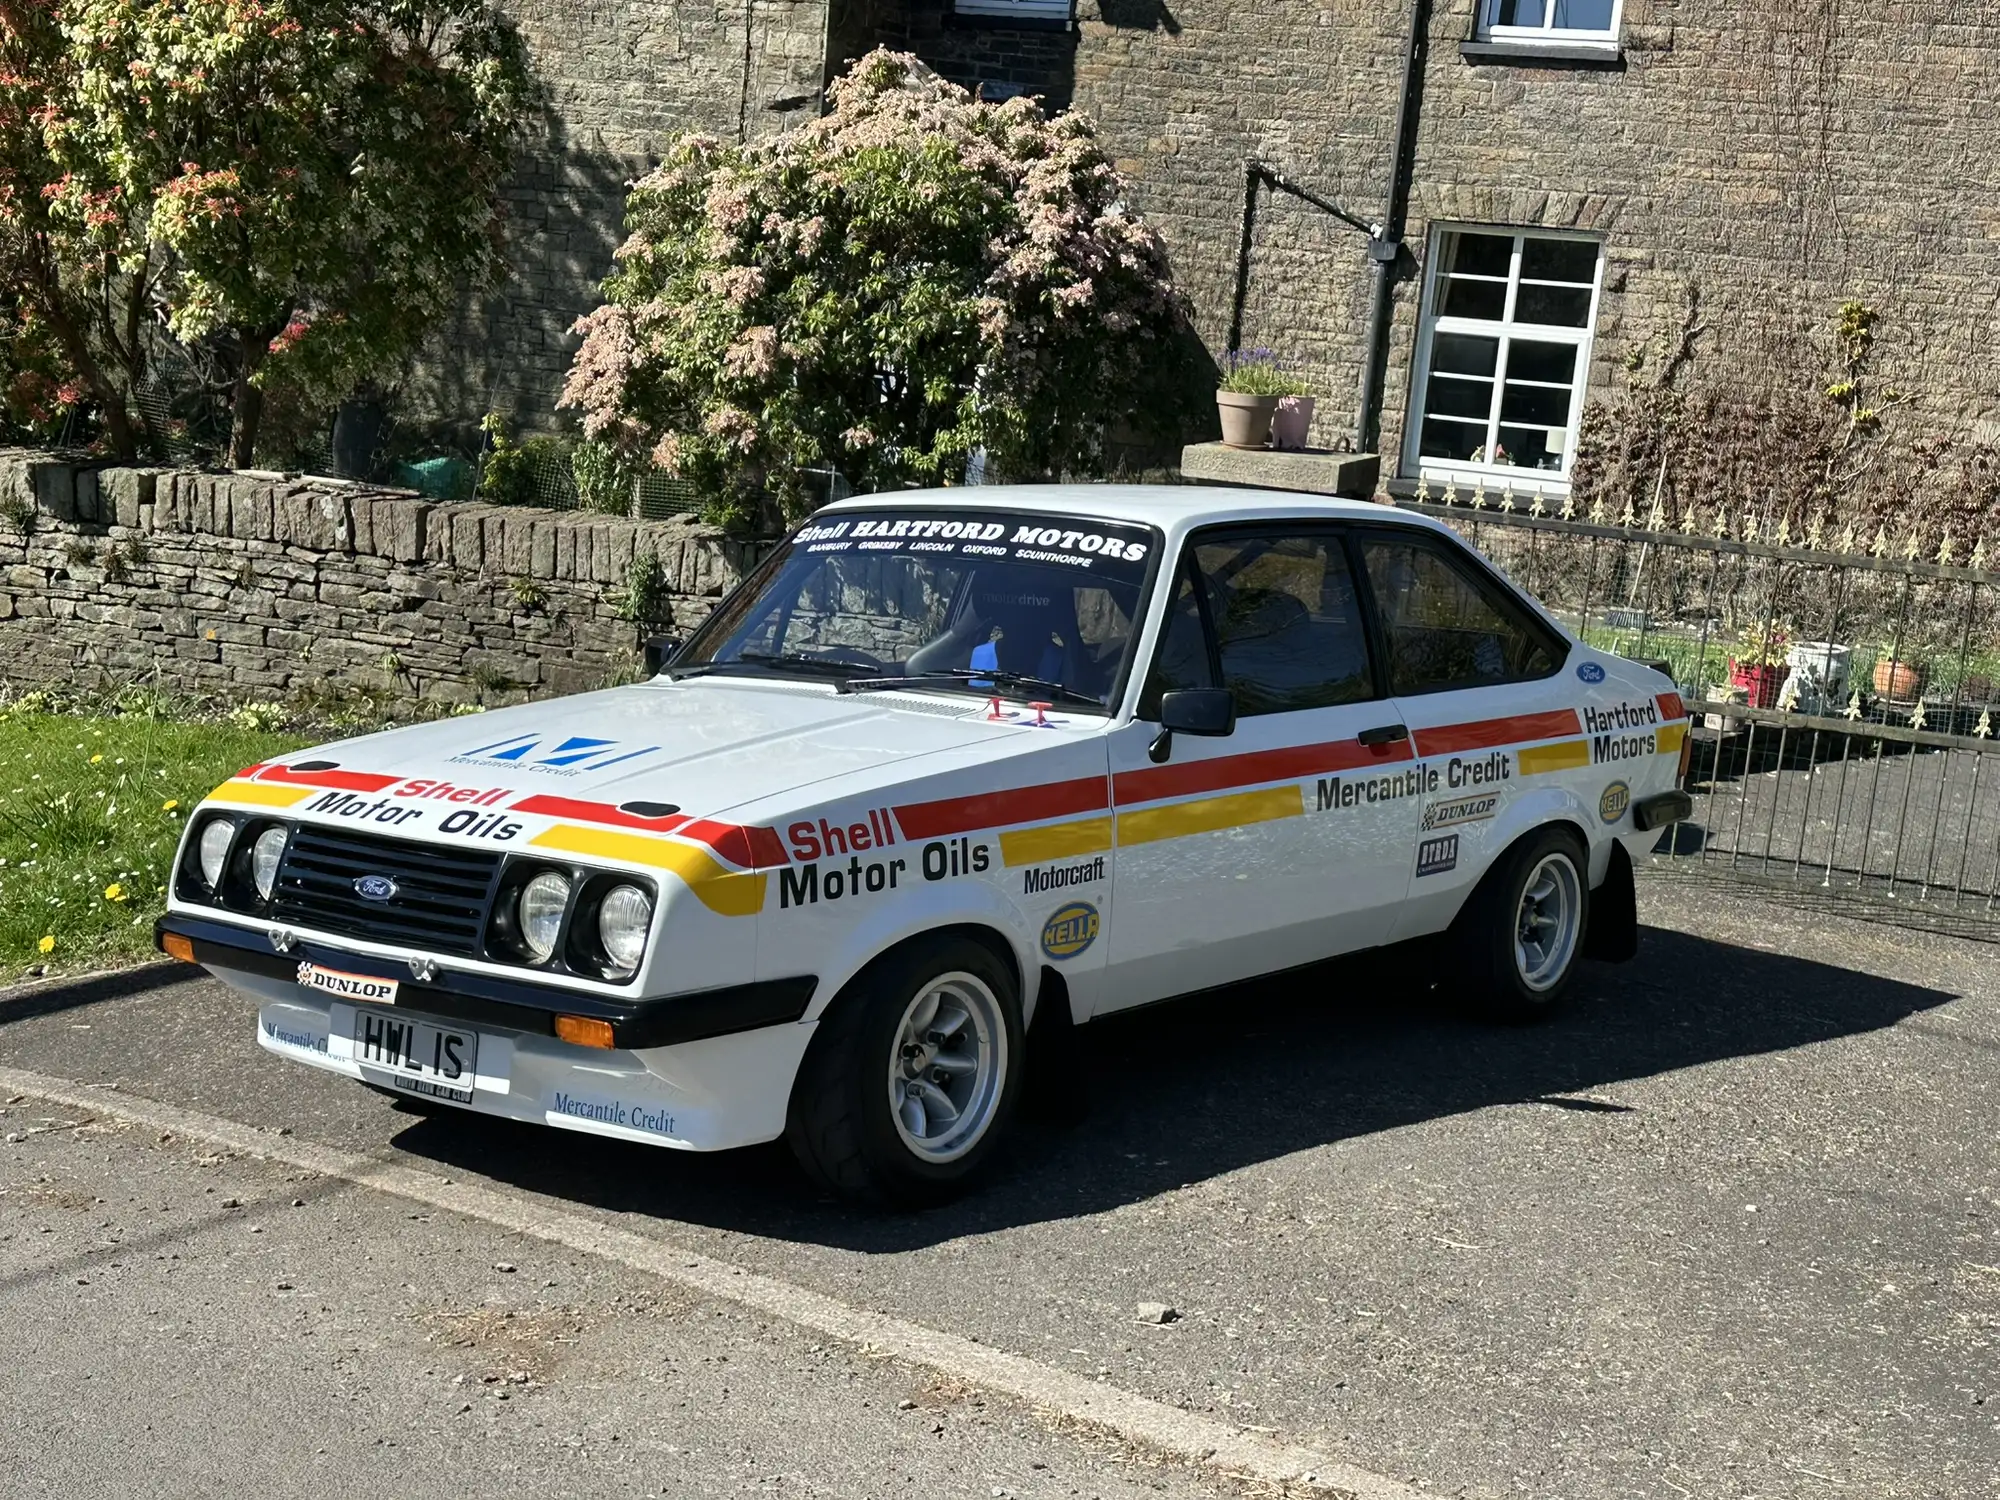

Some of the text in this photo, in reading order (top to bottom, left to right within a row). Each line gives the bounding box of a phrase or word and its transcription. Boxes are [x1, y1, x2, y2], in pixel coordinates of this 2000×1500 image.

[792, 520, 1147, 561] Shell HARTFORD MOTORS
[807, 541, 1093, 567] BANBURY GRIMSBY LINCOLN OXFORD SCUNTHORPE
[1583, 699, 1656, 734] Hartford
[1594, 734, 1655, 764] Motors
[394, 779, 515, 806] Shell
[1317, 752, 1509, 812] Mercantile Credit
[305, 792, 523, 840] Motor Oils
[1436, 799, 1496, 821] DUNLOP
[1601, 789, 1629, 813] HELLA
[788, 807, 895, 861] Shell
[779, 837, 990, 909] Motor Oils
[1024, 856, 1106, 894] Motorcraft
[1044, 913, 1100, 945] HELLA
[313, 972, 392, 998] DUNLOP
[364, 1015, 422, 1071] HWL
[554, 1092, 675, 1133] Mercantile Credit
